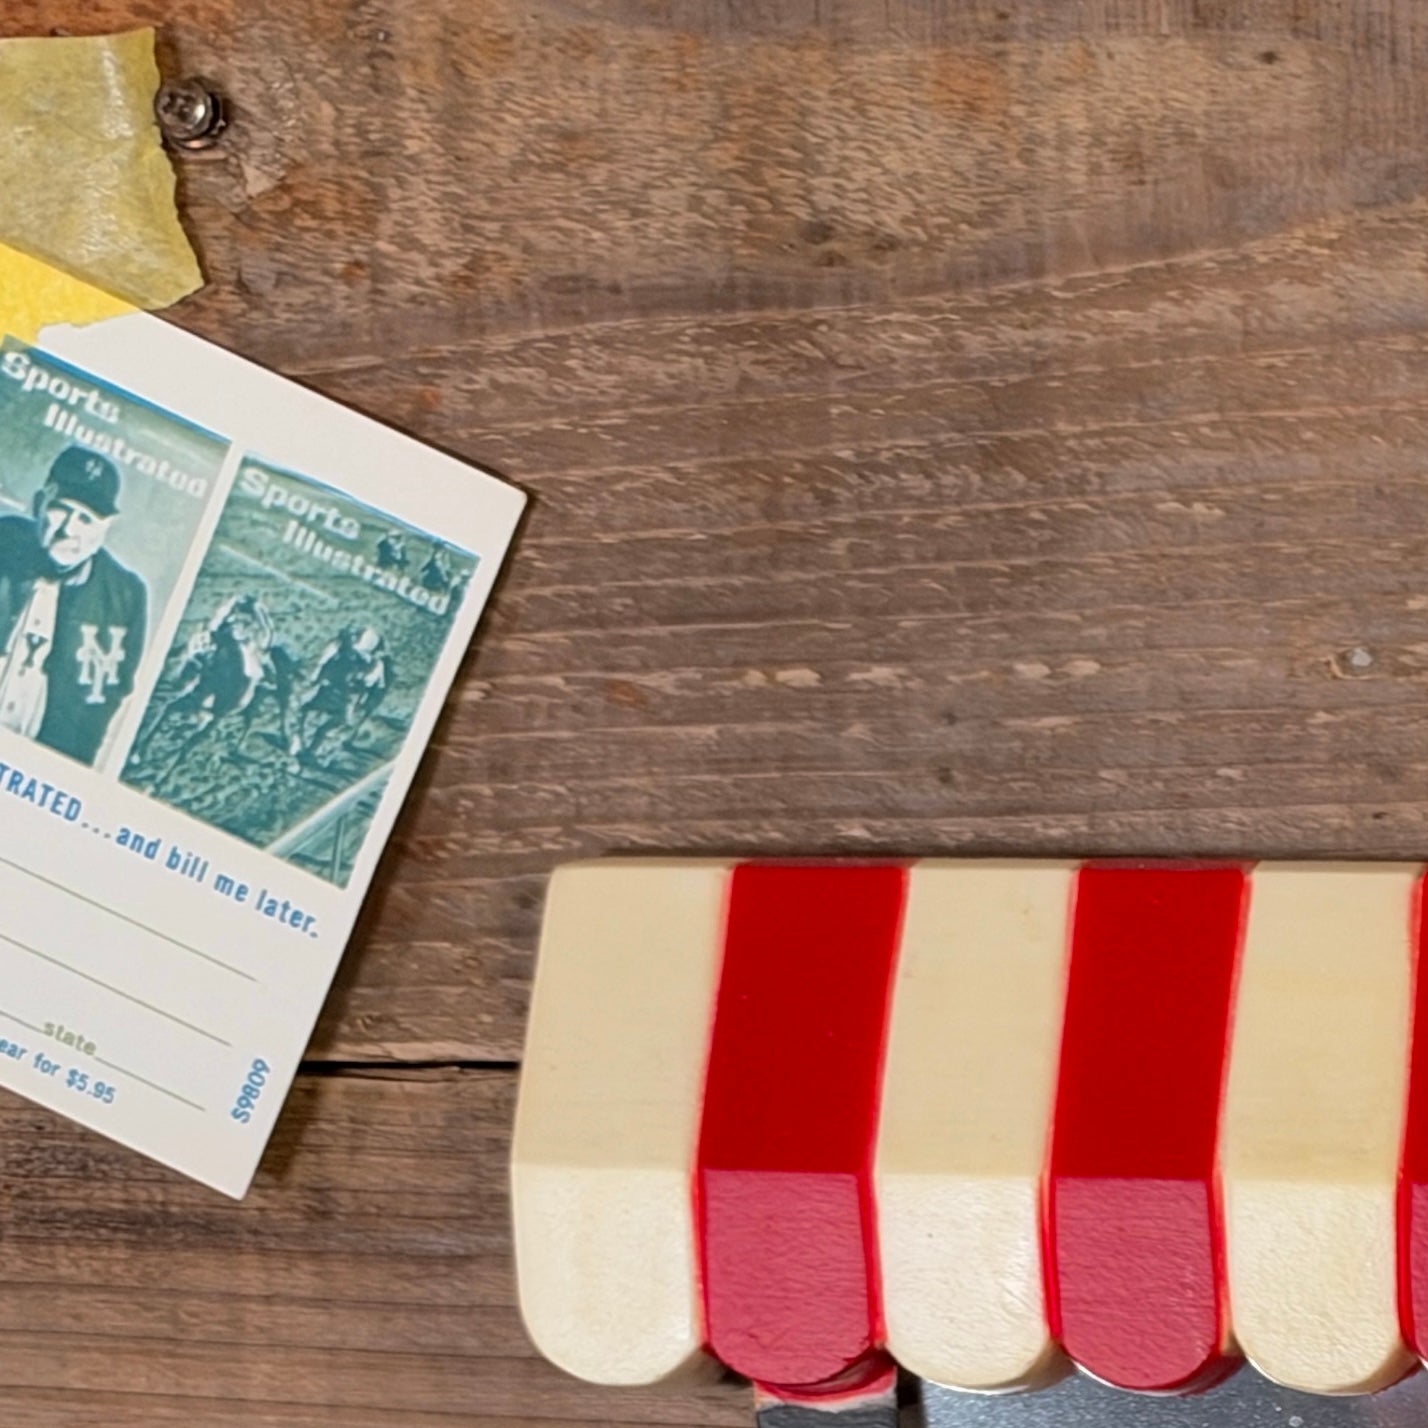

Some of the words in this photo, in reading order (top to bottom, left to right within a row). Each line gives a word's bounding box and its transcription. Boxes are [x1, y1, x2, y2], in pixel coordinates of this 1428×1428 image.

[0, 351, 121, 425] Sports
[238, 466, 361, 540] Sports
[283, 519, 450, 616] Illustrated
[115, 827, 162, 860] and
[165, 846, 209, 883] bill
[213, 873, 250, 902] me
[255, 889, 318, 938] later.
[44, 1021, 97, 1057] state
[33, 1053, 61, 1076] for
[66, 1068, 117, 1104] $5.95
